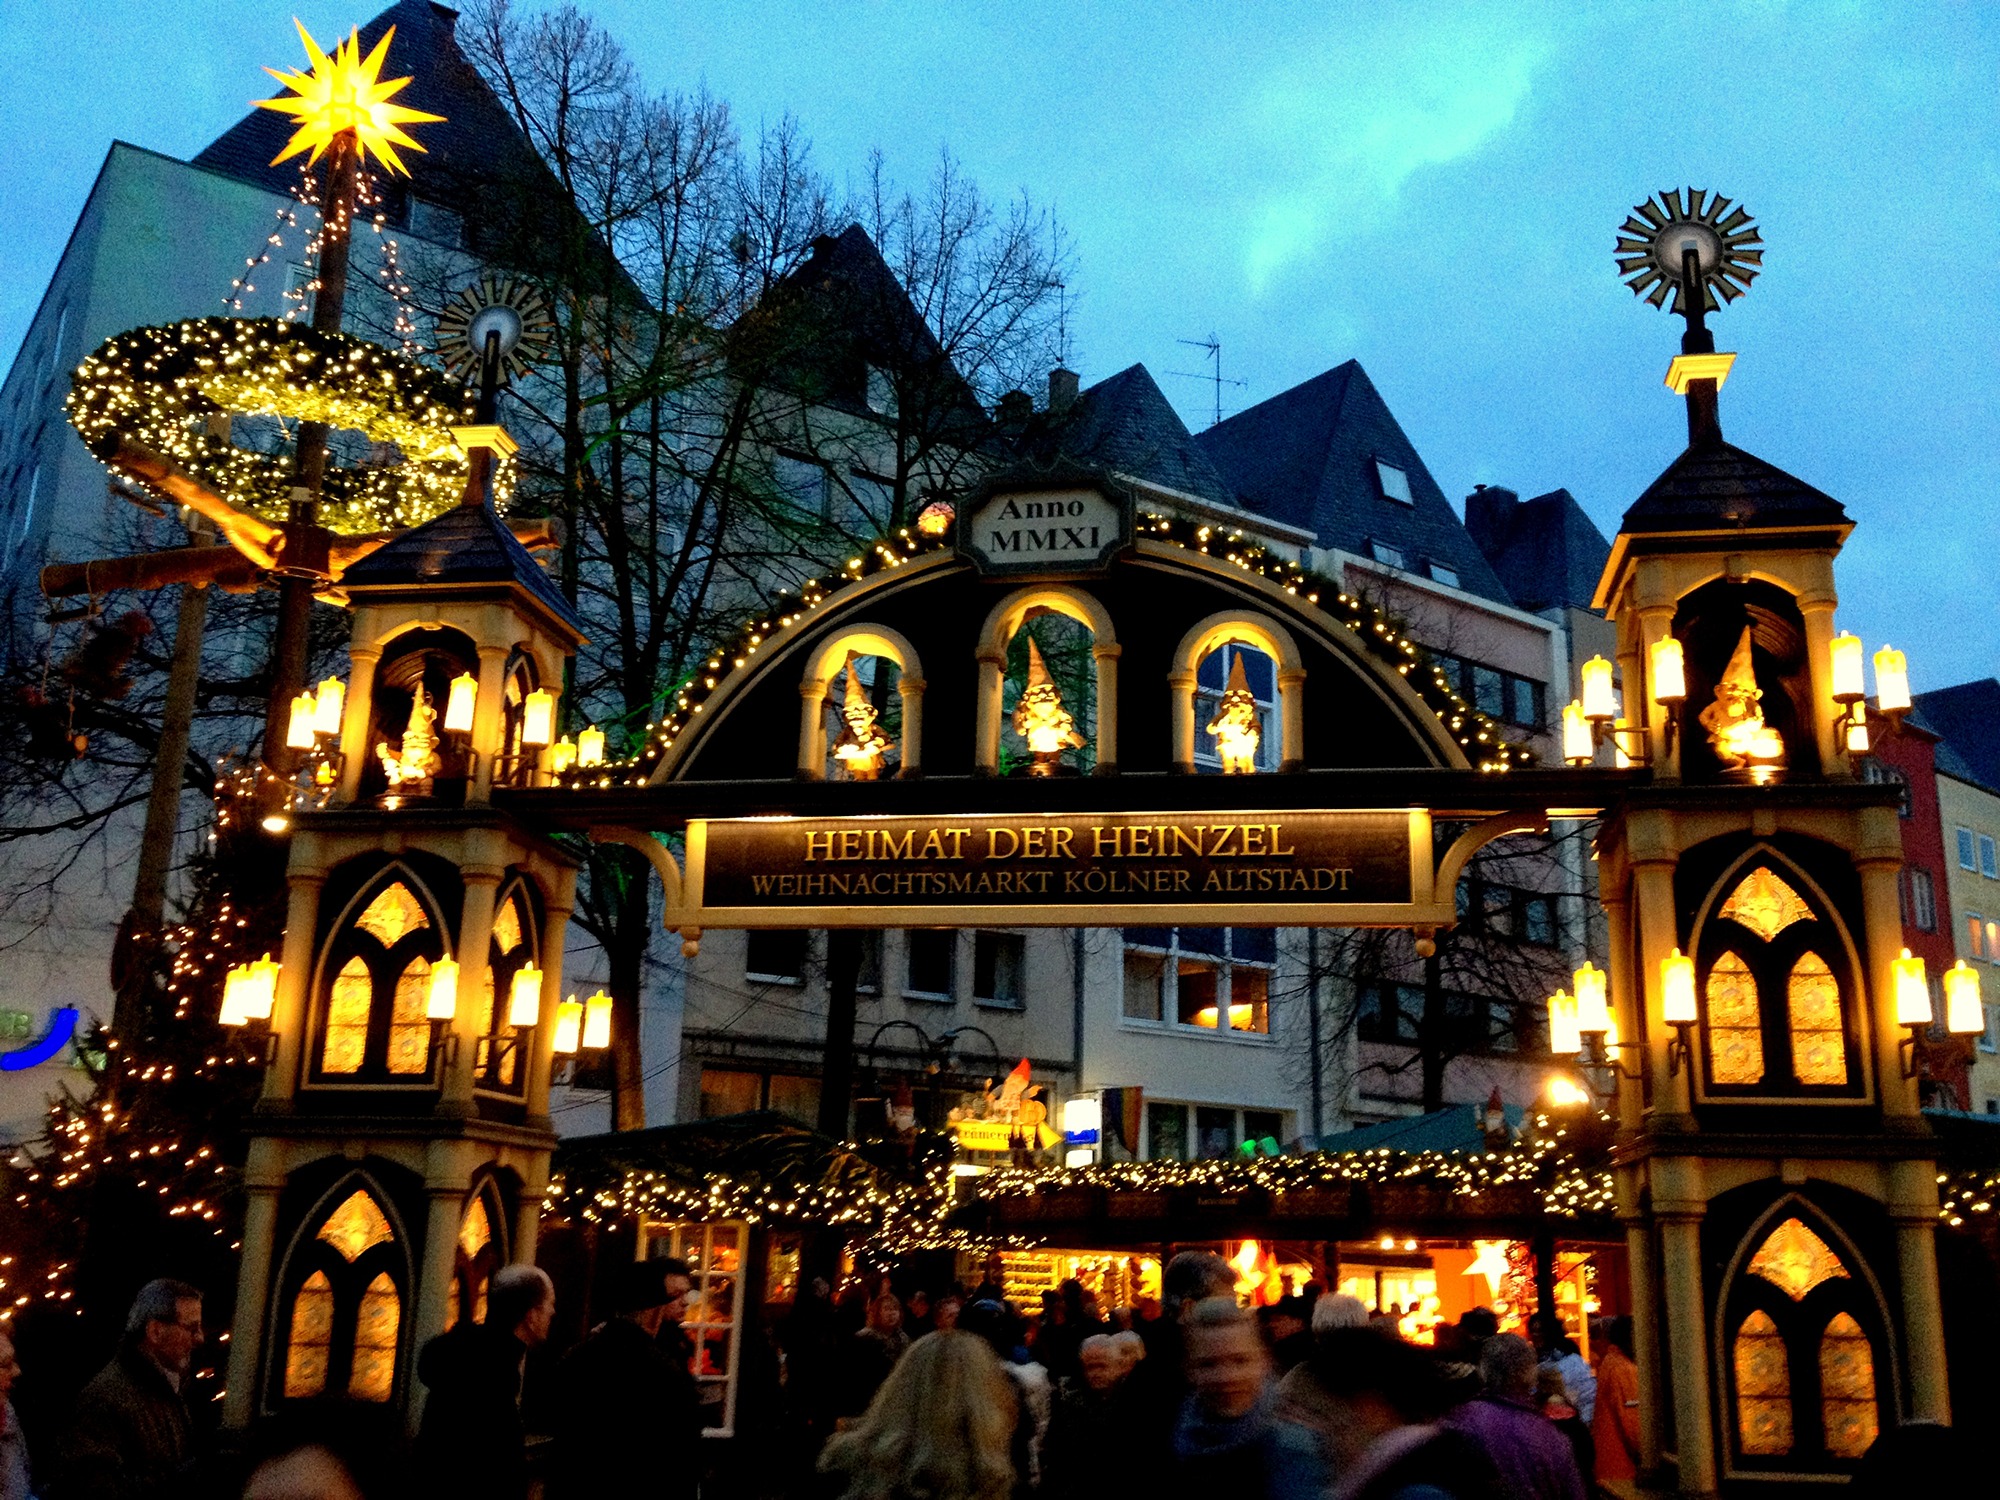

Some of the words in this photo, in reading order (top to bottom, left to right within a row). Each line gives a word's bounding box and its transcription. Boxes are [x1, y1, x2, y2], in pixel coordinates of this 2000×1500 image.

[997, 498, 1085, 521] Anno
[990, 526, 1101, 553] MMXI
[804, 827, 971, 861] HEIMAT
[985, 826, 1077, 859] DER
[1091, 823, 1296, 857] HEINZEL
[751, 870, 1053, 896] WEIHNACHTSMARKT
[1064, 866, 1193, 893] KÖLNER
[1202, 868, 1354, 892] ALTSTADT
